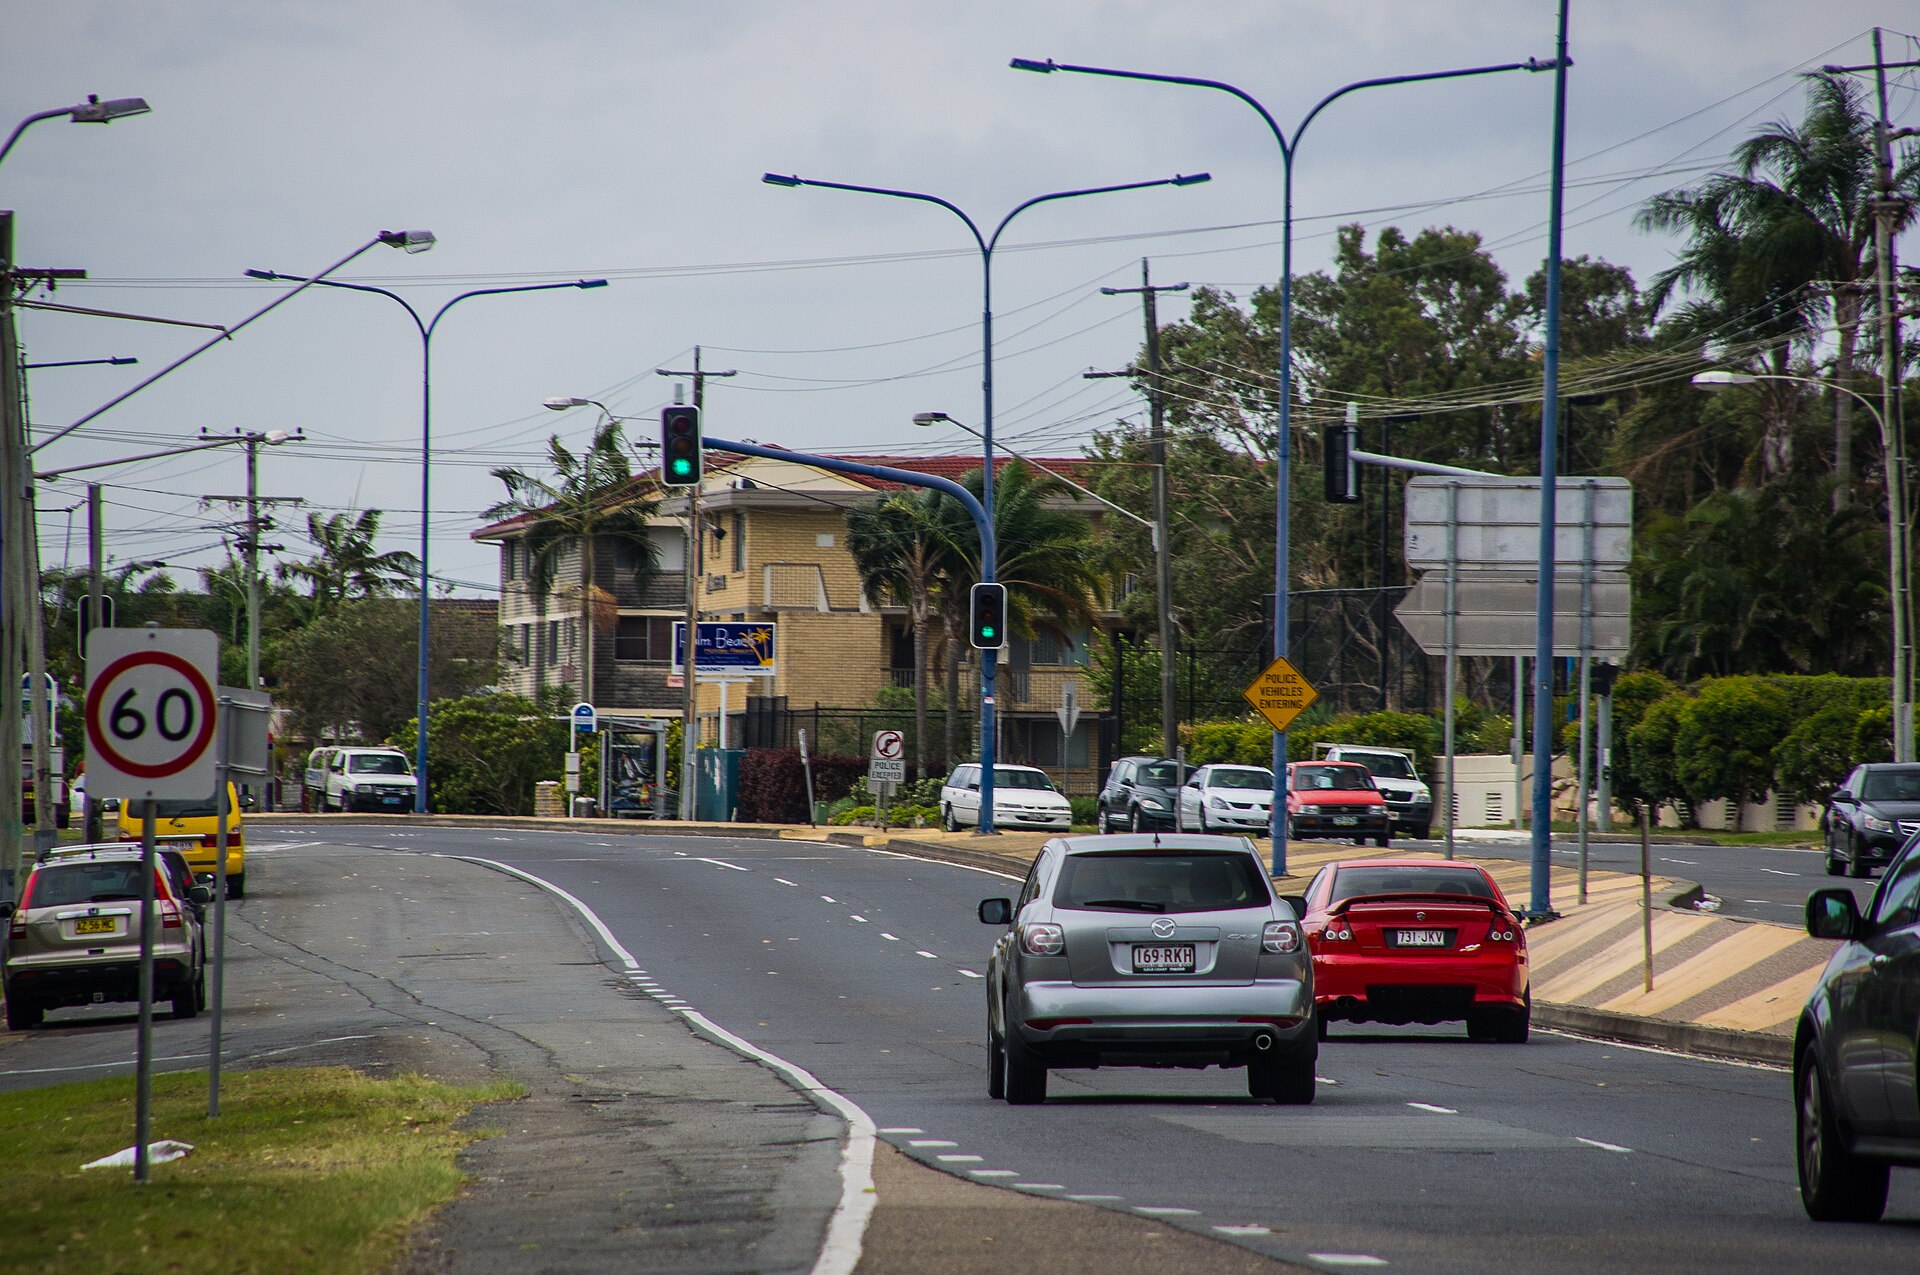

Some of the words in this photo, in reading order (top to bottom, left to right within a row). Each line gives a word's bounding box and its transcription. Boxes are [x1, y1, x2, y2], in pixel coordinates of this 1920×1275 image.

[1265, 674, 1298, 684] POLICE
[1260, 687, 1303, 697] VEHICLES
[1260, 700, 1303, 709] ENTERING
[110, 687, 194, 742] 60
[874, 761, 902, 770] POLICE
[872, 771, 902, 780] EXCEPTED
